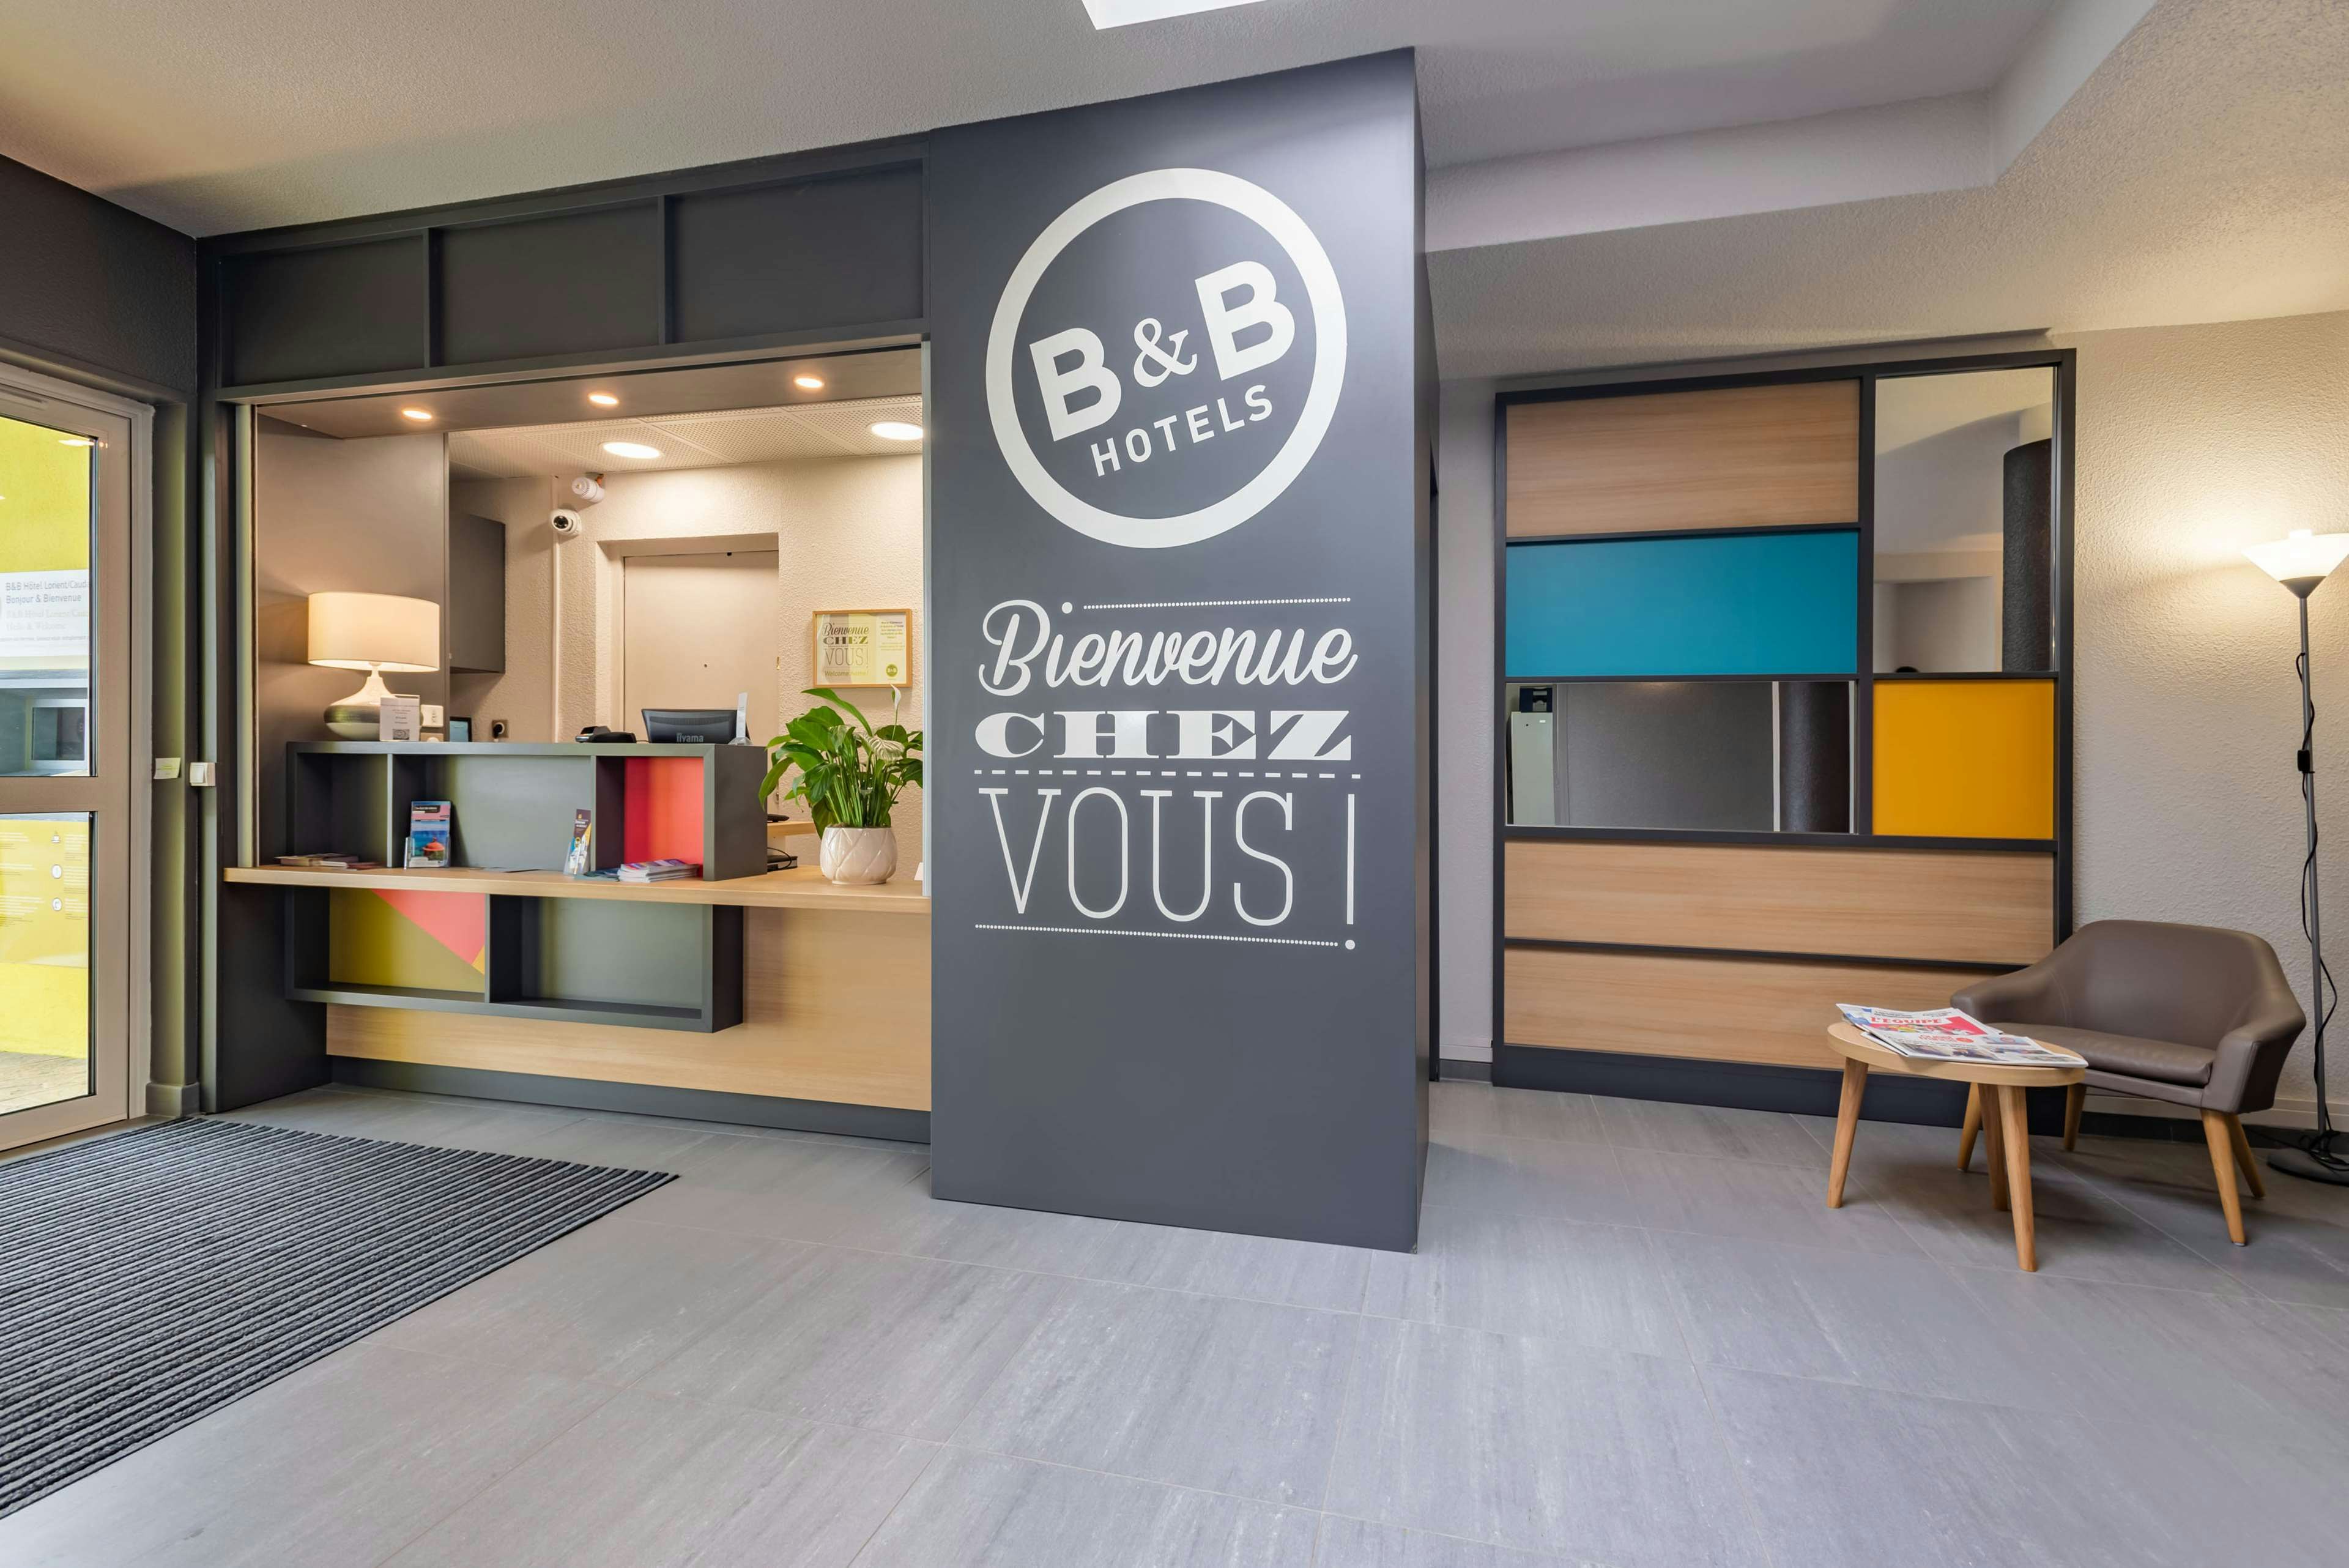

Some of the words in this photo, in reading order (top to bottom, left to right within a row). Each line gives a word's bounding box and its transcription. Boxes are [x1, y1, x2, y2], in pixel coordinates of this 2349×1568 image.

[1029, 261, 1296, 442] B&B
[1091, 384, 1273, 477] HOTELS
[6, 582, 21, 591] B&B
[6, 595, 34, 605] Bonjour
[43, 593, 82, 603] Bienvenue
[822, 622, 870, 637] Bienvenue
[823, 636, 868, 645] CHEZ
[979, 600, 1358, 696] Bienvenue
[974, 710, 1351, 760] CHEZ
